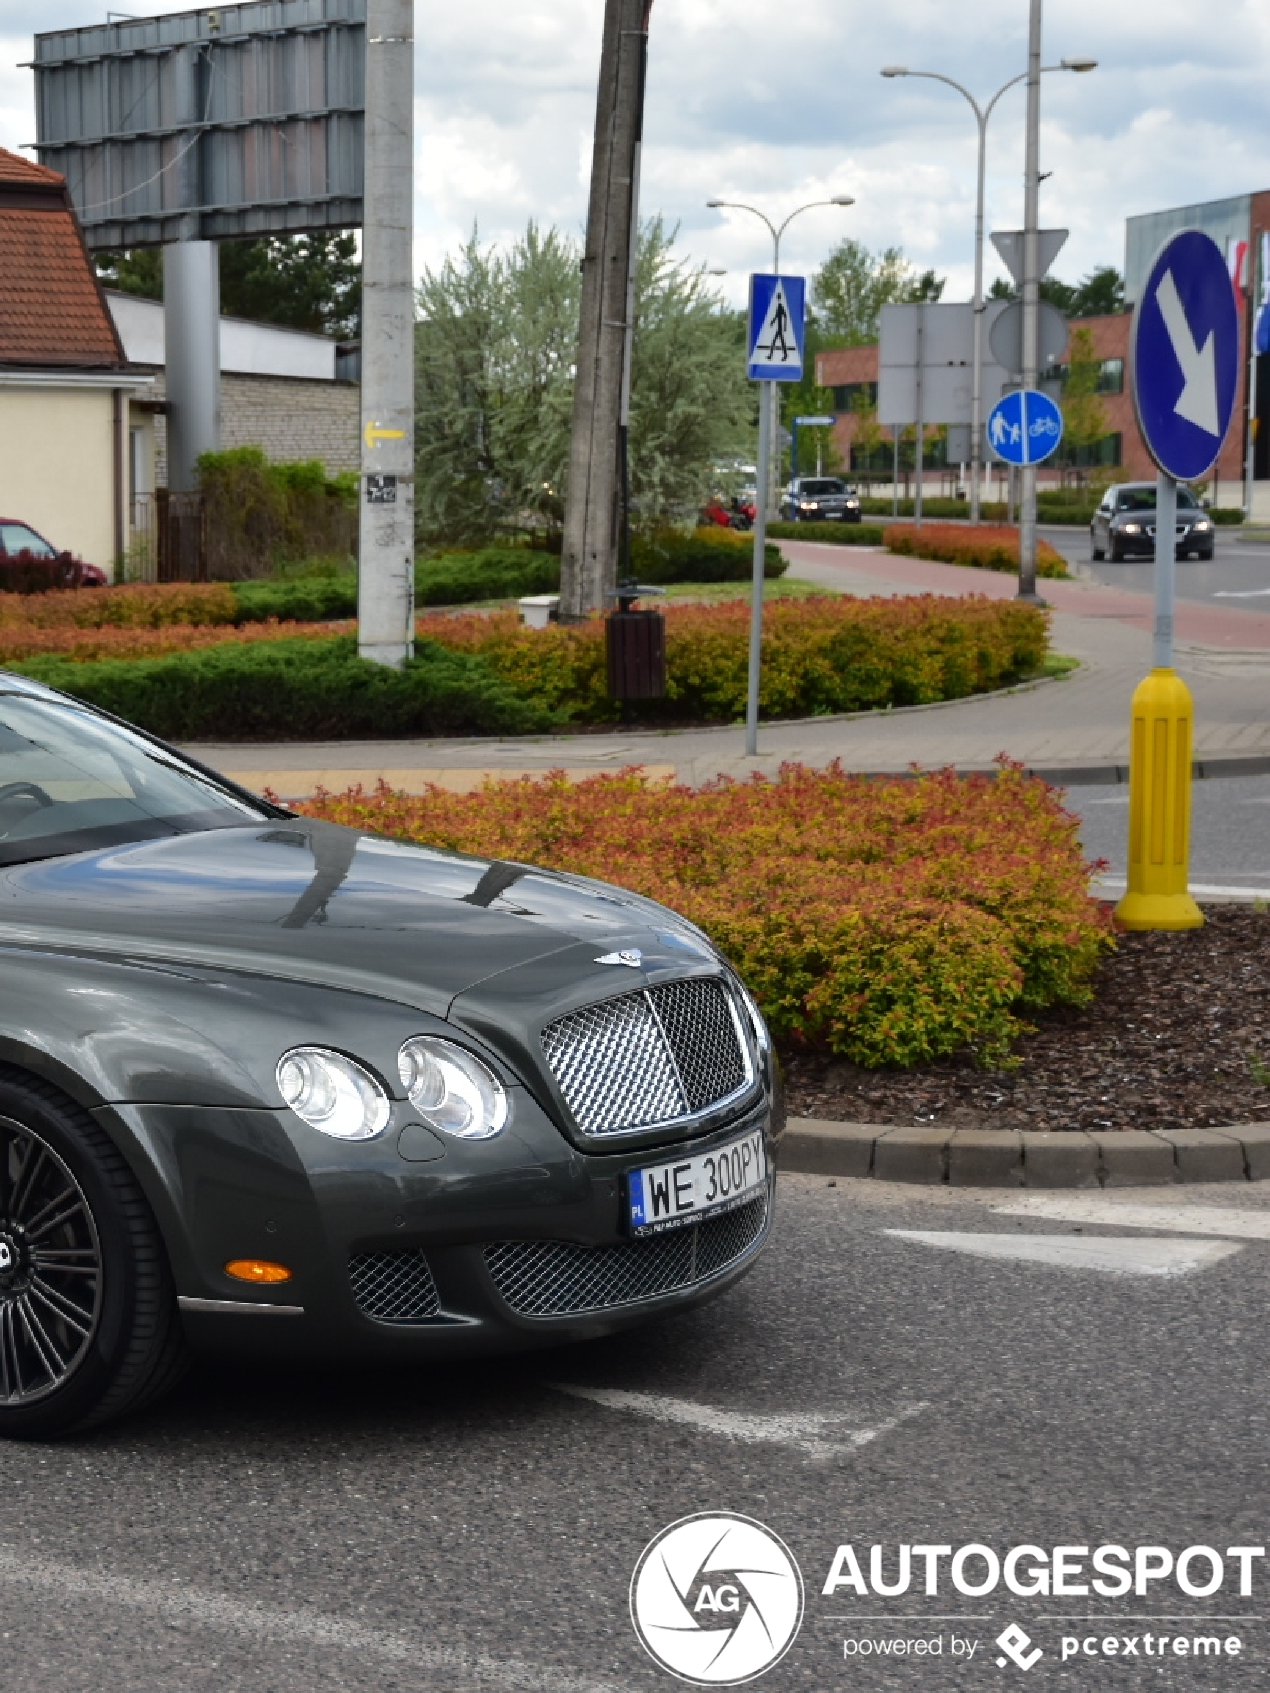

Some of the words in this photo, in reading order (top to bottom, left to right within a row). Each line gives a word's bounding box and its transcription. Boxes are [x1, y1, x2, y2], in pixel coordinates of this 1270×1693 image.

[648, 1162, 694, 1217] WE
[702, 1133, 763, 1202] 300PY
[631, 1205, 644, 1219] PL
